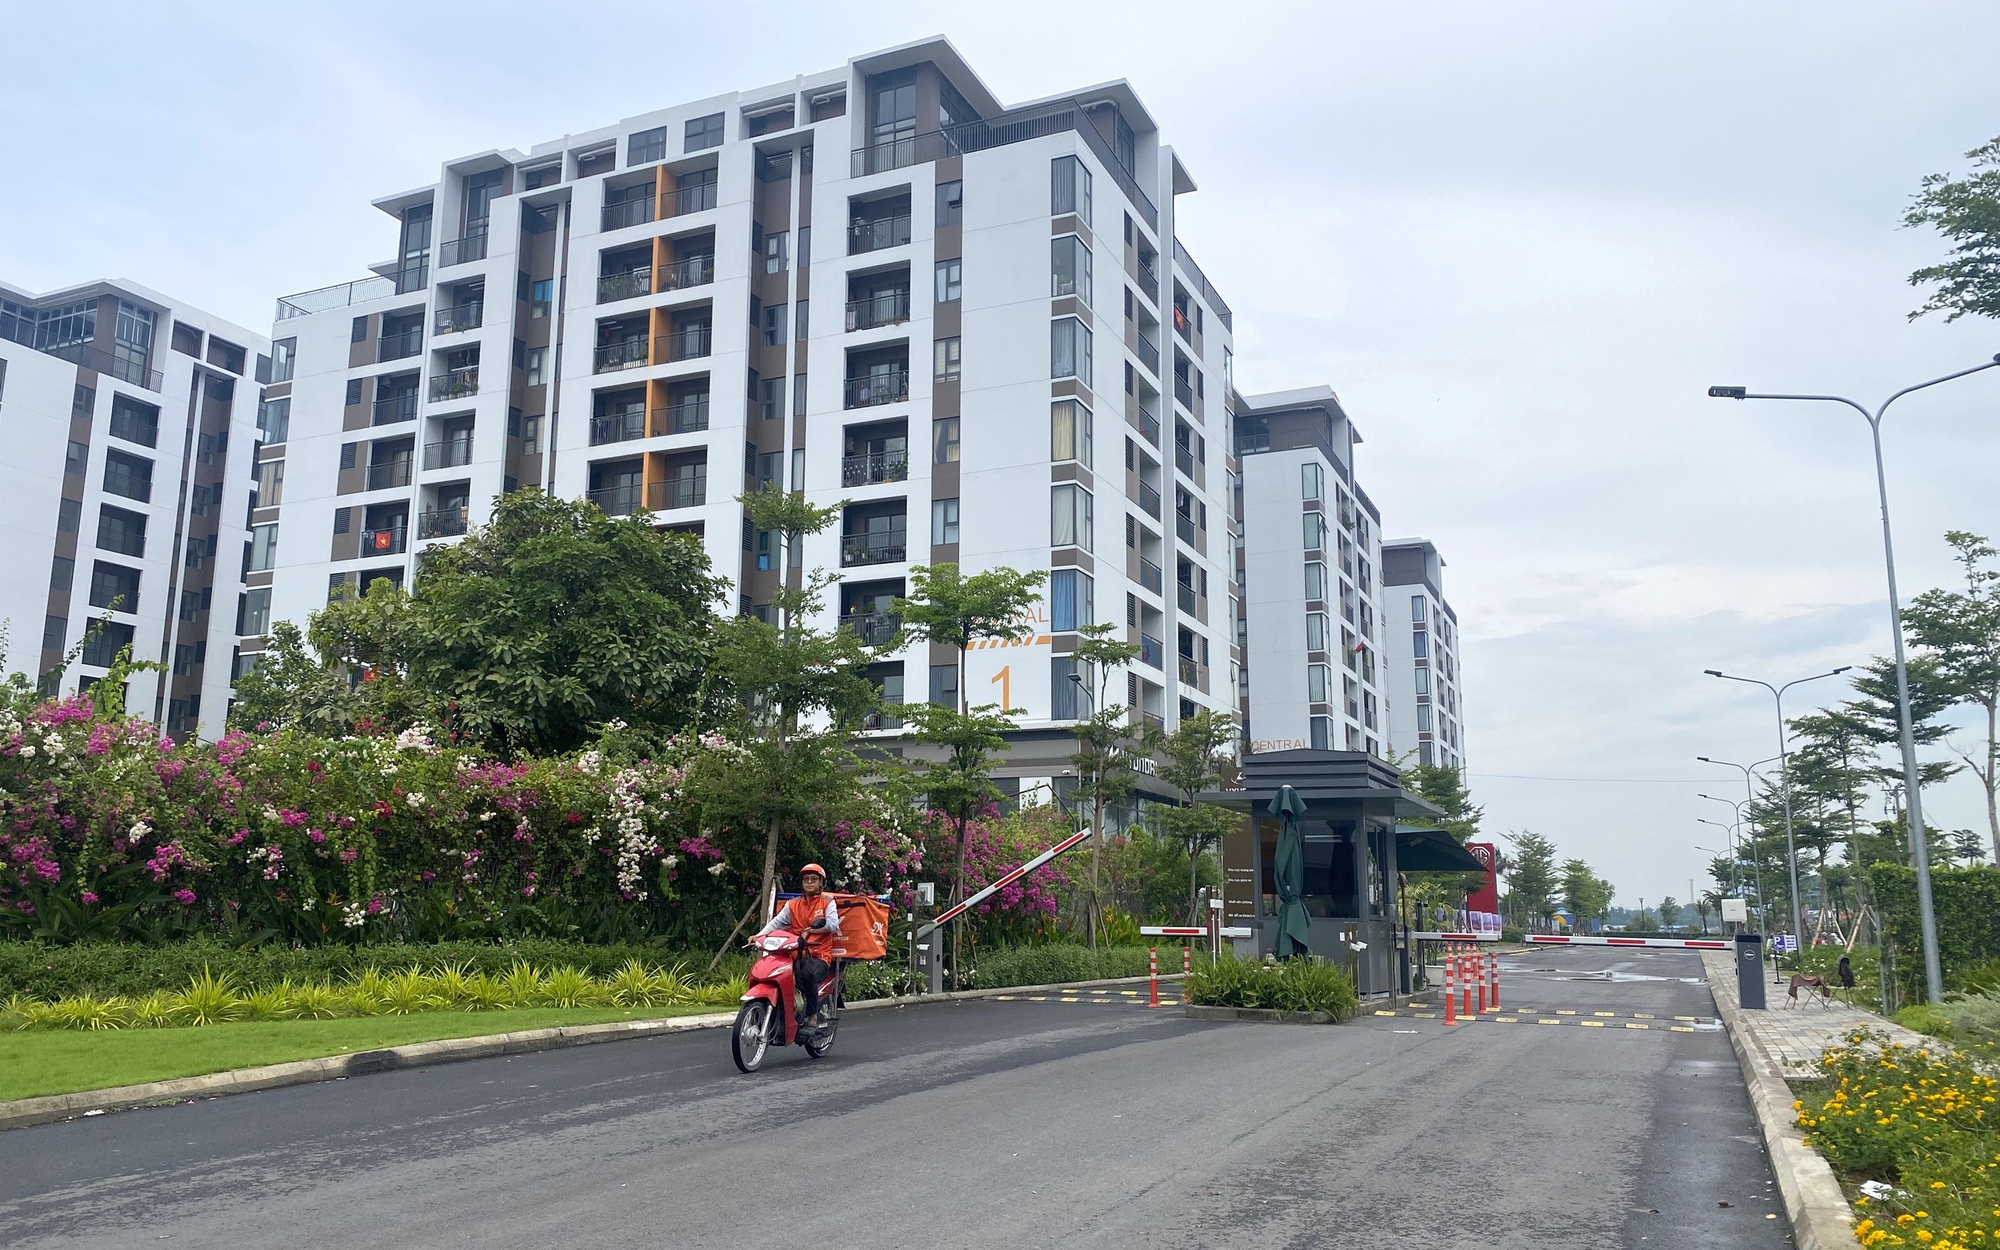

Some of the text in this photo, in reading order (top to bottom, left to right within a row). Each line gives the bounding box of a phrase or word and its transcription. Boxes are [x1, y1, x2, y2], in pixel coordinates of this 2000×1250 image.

[991, 665, 1010, 712] 1
[1251, 738, 1309, 752] CENTRAL
[1774, 936, 1781, 945] P
